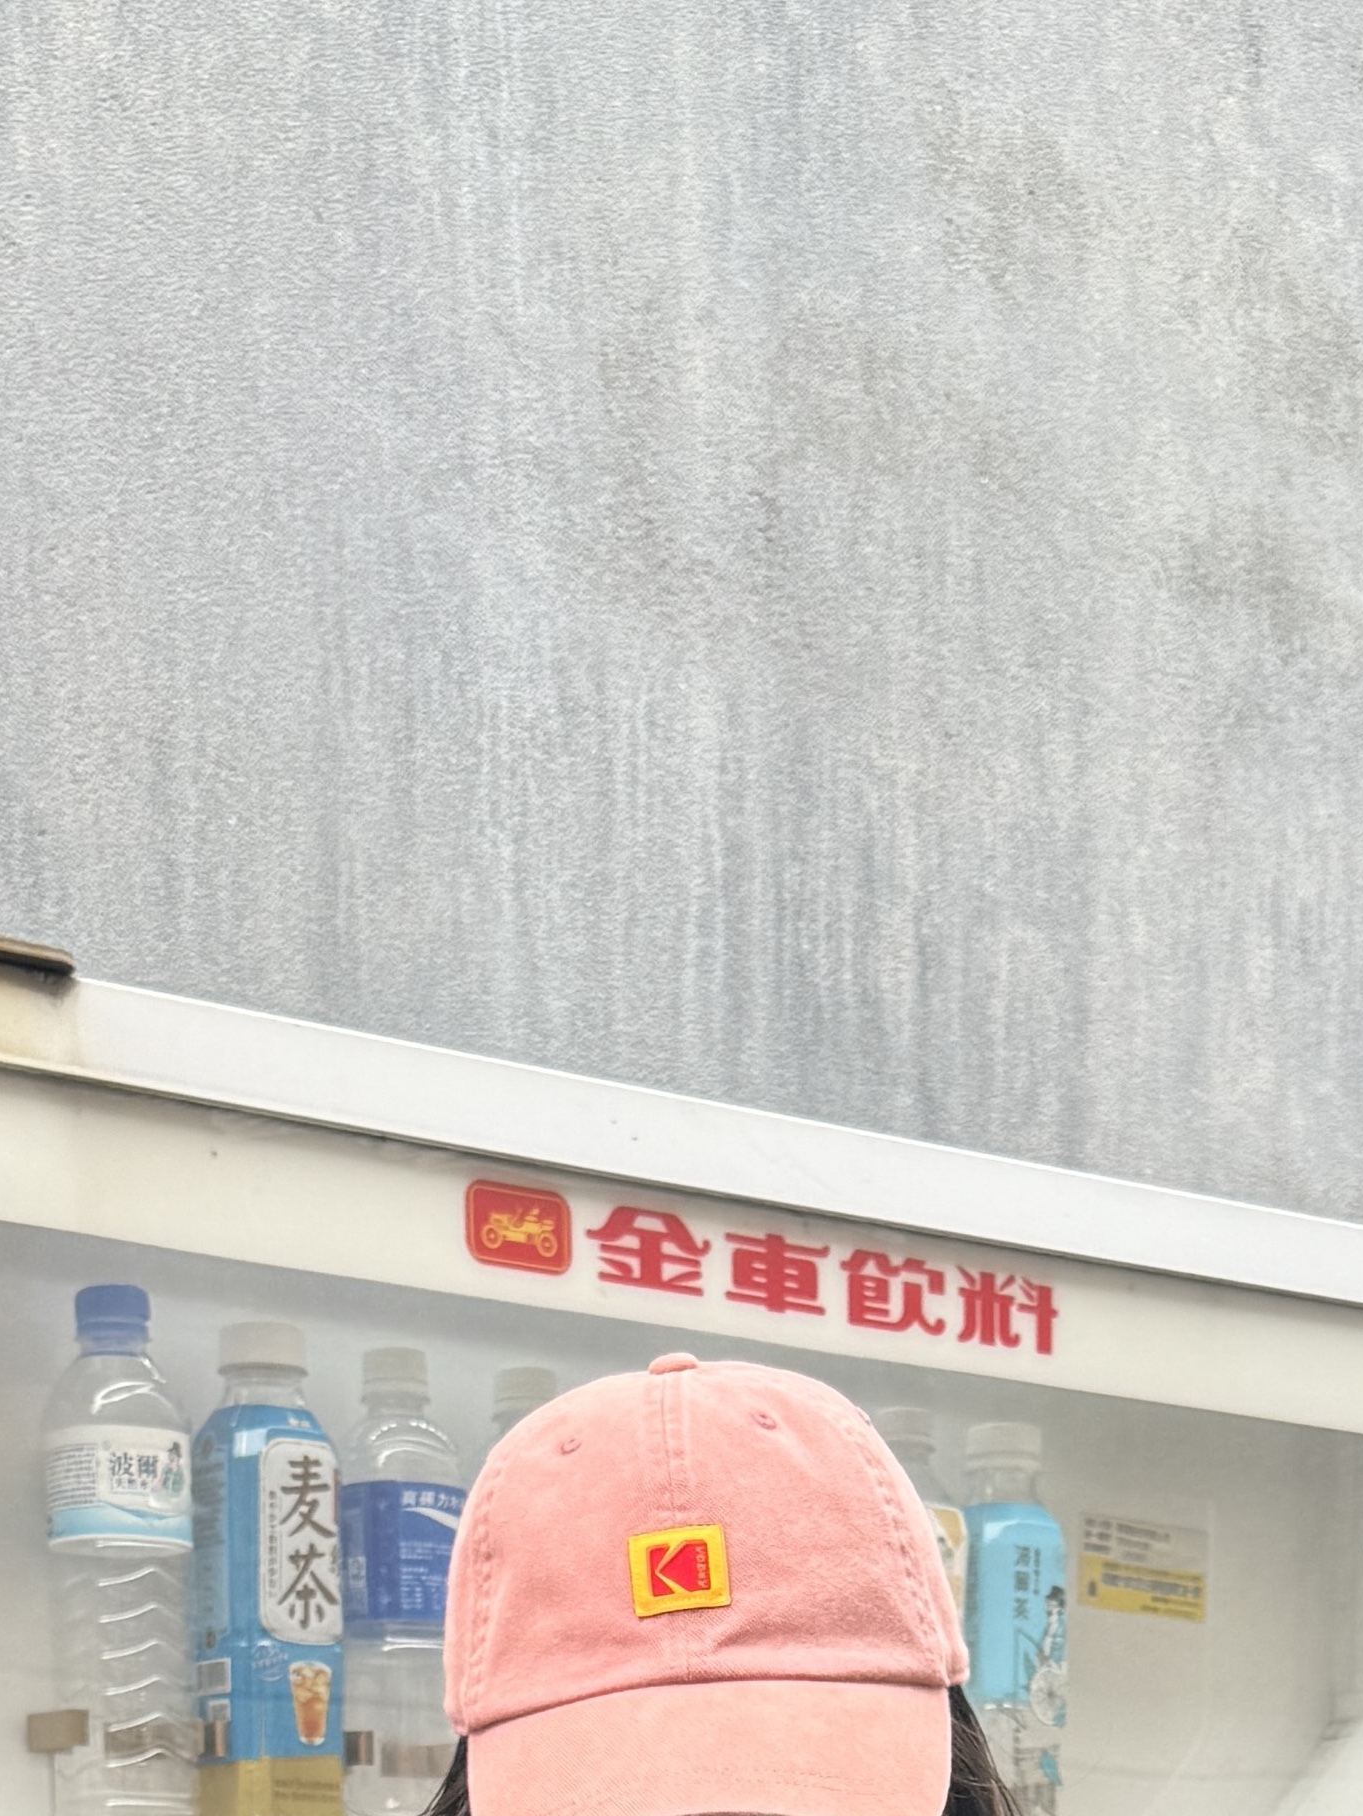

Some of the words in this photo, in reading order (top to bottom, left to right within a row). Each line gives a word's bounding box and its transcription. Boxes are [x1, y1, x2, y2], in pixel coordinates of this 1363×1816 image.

[586, 1205, 1060, 1356] 金車飲料
[278, 1454, 339, 1630] 麦茶
